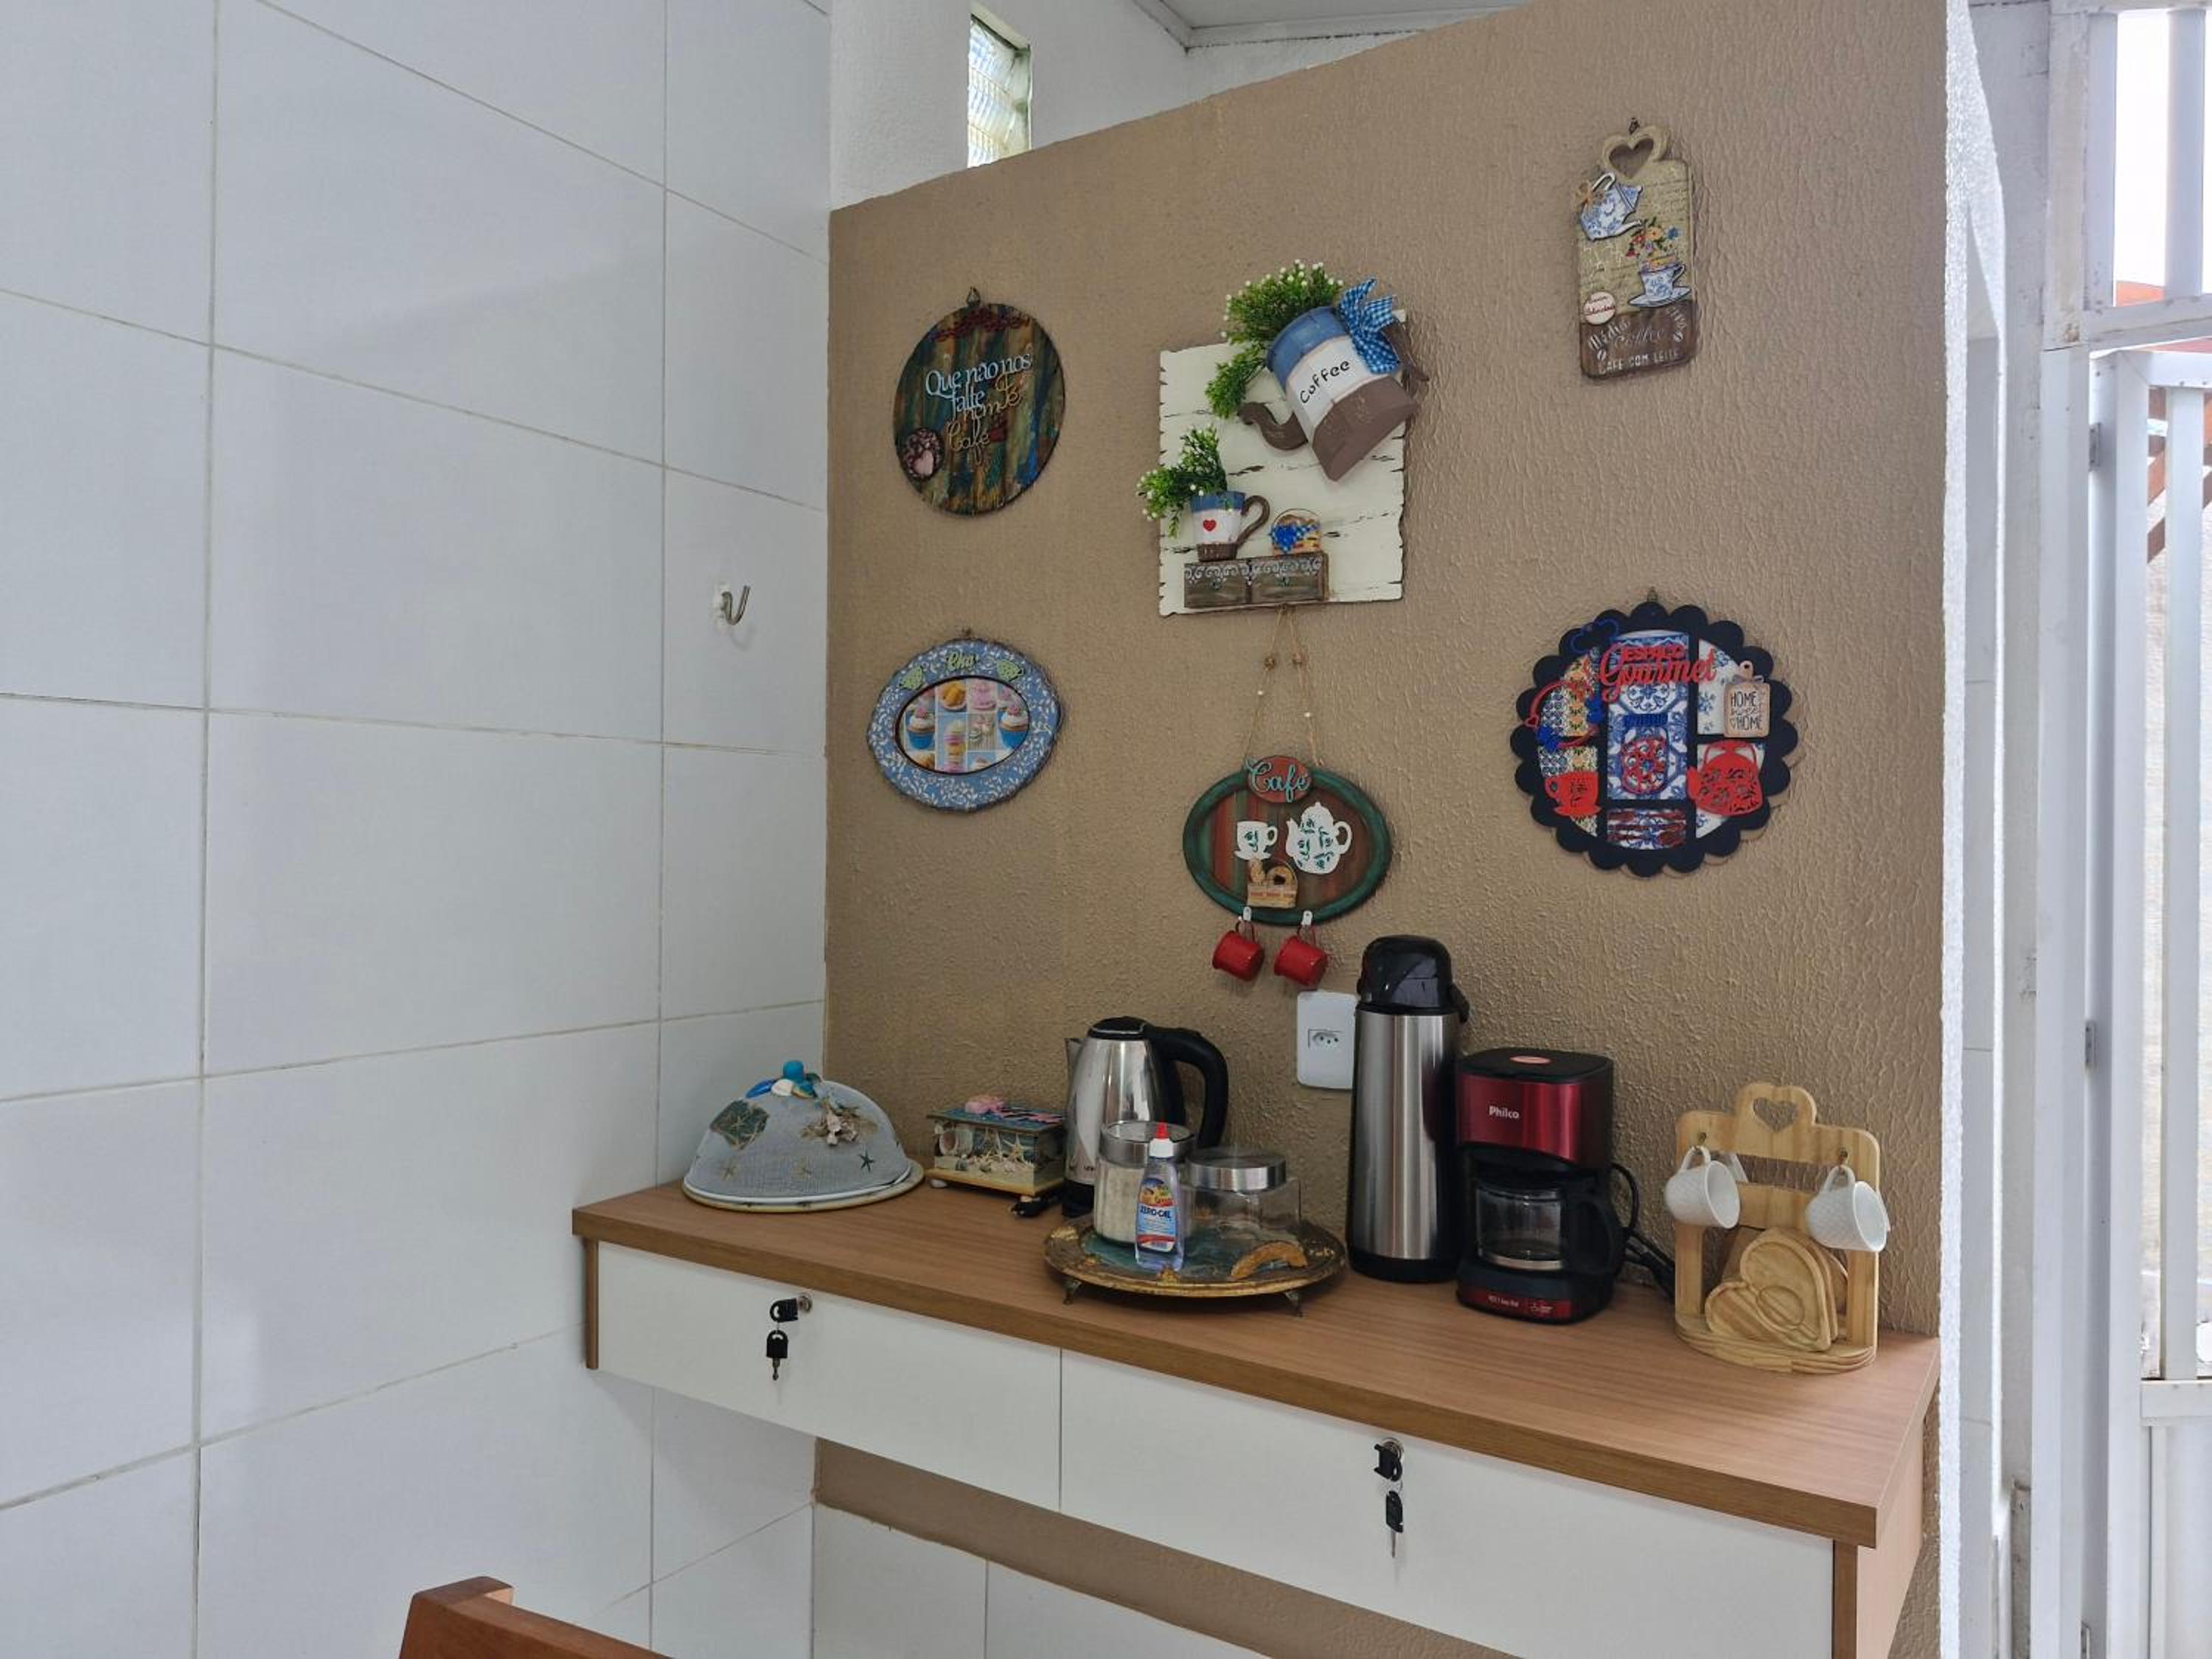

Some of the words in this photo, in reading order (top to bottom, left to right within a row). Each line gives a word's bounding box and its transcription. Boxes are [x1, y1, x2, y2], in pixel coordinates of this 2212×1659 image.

[925, 369, 961, 399] Que
[1001, 353, 1032, 374] nos
[1300, 361, 1350, 403] Coffee
[952, 382, 986, 420] falte
[1600, 642, 1717, 703] Gourmet
[1731, 691, 1758, 707] HOME
[1736, 714, 1763, 731] HOME
[1246, 759, 1310, 803] Café
[1489, 1105, 1520, 1119] Philco
[1139, 1206, 1172, 1219] ZERO-CAL
